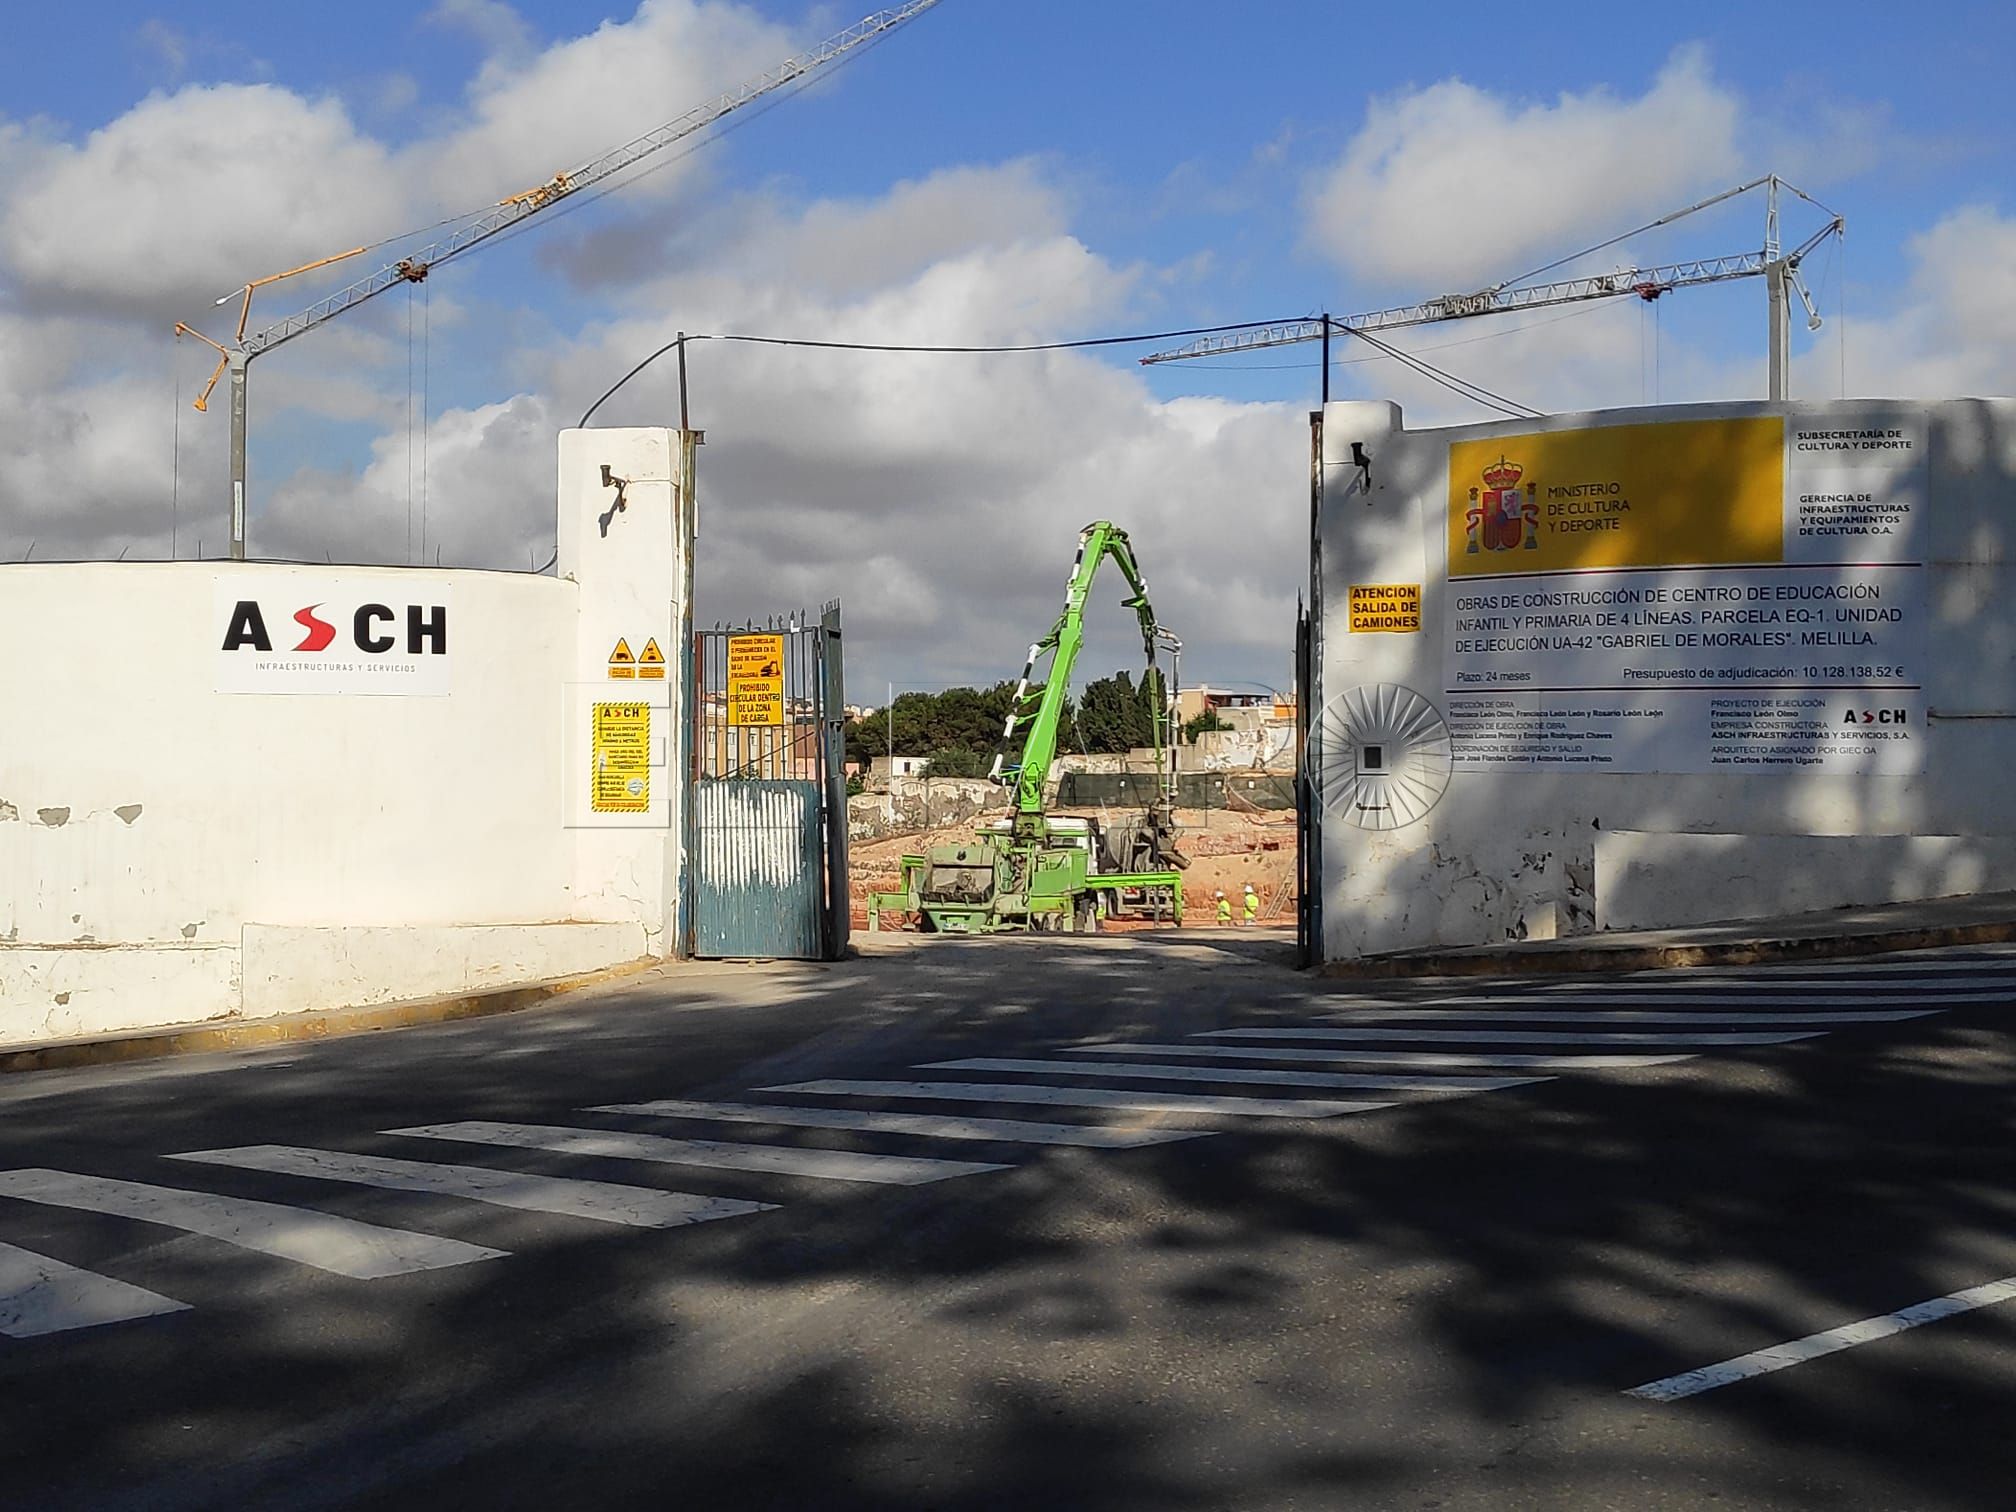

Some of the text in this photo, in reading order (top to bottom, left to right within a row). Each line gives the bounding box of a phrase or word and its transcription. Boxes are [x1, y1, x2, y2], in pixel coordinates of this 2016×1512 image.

[1797, 429, 1902, 440] SUBSECRETARÍA DE
[1797, 440, 1912, 451] CULTURA Y DEPORTE
[1547, 482, 1620, 498] MINISTERIO
[1799, 494, 1872, 503] GERENCIA DE
[1547, 500, 1631, 516] DE CULTURA
[1799, 504, 1911, 514] INFRAESTRUCTURAS
[1547, 518, 1620, 533] Y DEPORTE
[1799, 515, 1900, 526] Y EQUIPAMIENTOS
[1799, 527, 1813, 536] DE
[1815, 526, 1869, 535] CULTURA
[1352, 587, 1416, 599] ATENCION
[1456, 582, 1880, 611] OBRAS DE CONSTRUCCIÓN DE CENTRO DE EDUCACIÓN
[1353, 602, 1417, 614] SALIDA DE
[1353, 616, 1419, 628] CAMIONES
[1455, 608, 1903, 631] INFANTIL Y PRIMARIA DE 4 LÍNEAS. PARCELA EQ-1. UNIDAD
[221, 600, 447, 655] ASCH
[1455, 640, 1471, 653] DE
[1474, 635, 1550, 652] EJECUCIÓN
[1552, 637, 1593, 650] UA-42
[1597, 634, 1670, 648] "GABRIEL
[1675, 634, 1698, 647] DE
[1801, 631, 1877, 646] MELILLA.
[255, 662, 416, 673] INFRAESTRUCTURAS Y SERVICIOS
[1456, 671, 1531, 682] Plazo: 24 meses
[1623, 668, 1696, 681] Presupuesto
[1699, 667, 1714, 679] de
[1717, 667, 1798, 681] adjudicación:
[1895, 666, 1905, 677] €
[739, 683, 770, 692] PROHIBIDO
[730, 694, 757, 702] CIRCULAR
[1710, 698, 1826, 708] PROYECTO DE EJECUCIÓN
[738, 703, 771, 712] DE LA ZONA
[740, 714, 748, 723] DE
[1710, 709, 1799, 718] Francisco León Olmo
[1844, 709, 1906, 724] ASCH
[1710, 720, 1829, 730] EMPRESA CONSTRUCTORA
[1711, 731, 1736, 739] ASCH
[1737, 731, 1830, 740] INFRAESTRUCTURAS
[1840, 731, 1891, 741] SERVICIOS,
[1893, 732, 1910, 740] S.A.
[1711, 746, 1767, 755] ARQUITECTO
[1769, 746, 1816, 755] ASIGNADO
[1817, 746, 1837, 755] POR
[1839, 746, 1861, 755] GIEC
[1711, 756, 1731, 764] Juan
[1733, 756, 1760, 764] Carlos
[1795, 756, 1824, 765] Ugarte
